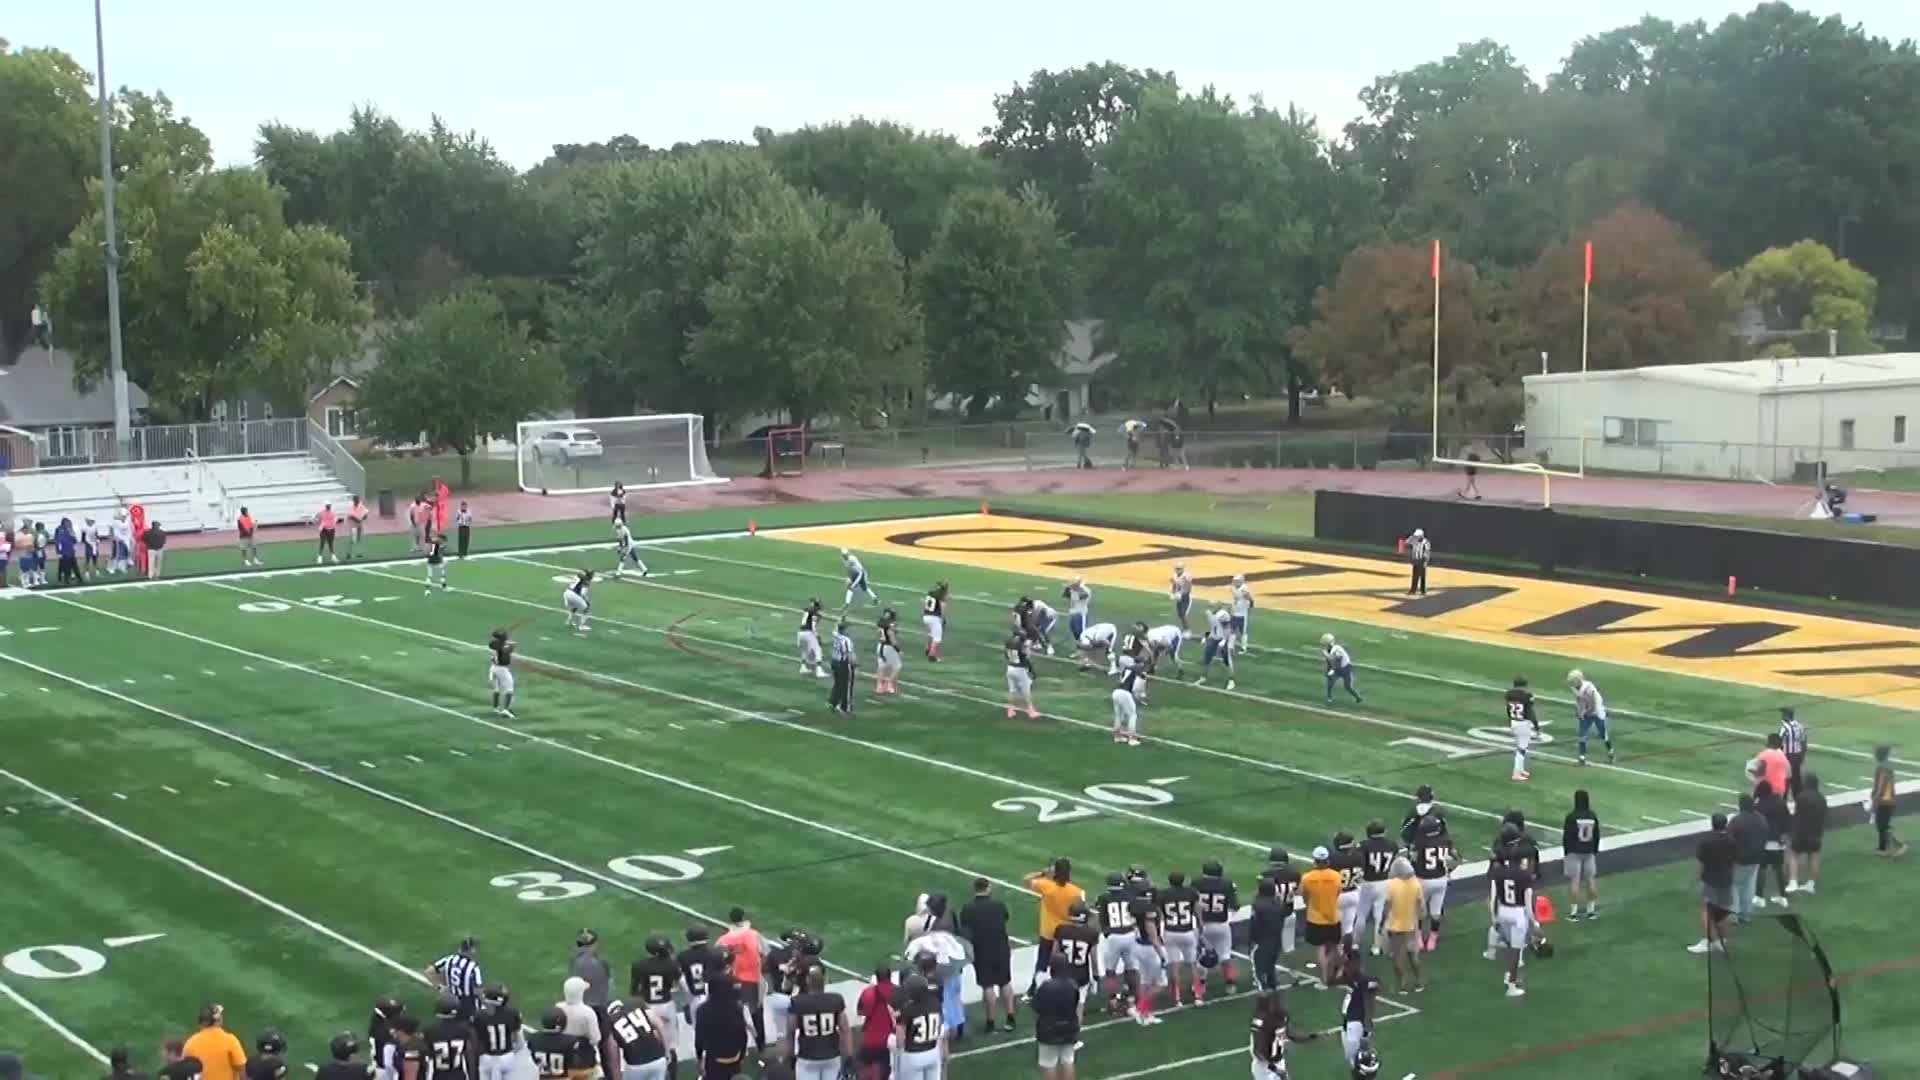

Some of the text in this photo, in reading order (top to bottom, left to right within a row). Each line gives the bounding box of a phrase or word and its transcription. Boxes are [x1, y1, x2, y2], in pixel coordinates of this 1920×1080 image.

[992, 783, 1174, 822] 20
[1368, 851, 1393, 873] 47
[1424, 847, 1450, 870] 54
[489, 854, 705, 901] 30
[1503, 879, 1517, 905] 6
[1163, 901, 1191, 927] 55
[1, 944, 107, 979] 0
[449, 967, 463, 987] S
[648, 975, 664, 1001] 2
[486, 1023, 508, 1052] 11
[613, 1007, 652, 1044] 64
[911, 1013, 941, 1044] 30
[433, 1040, 464, 1071] 27
